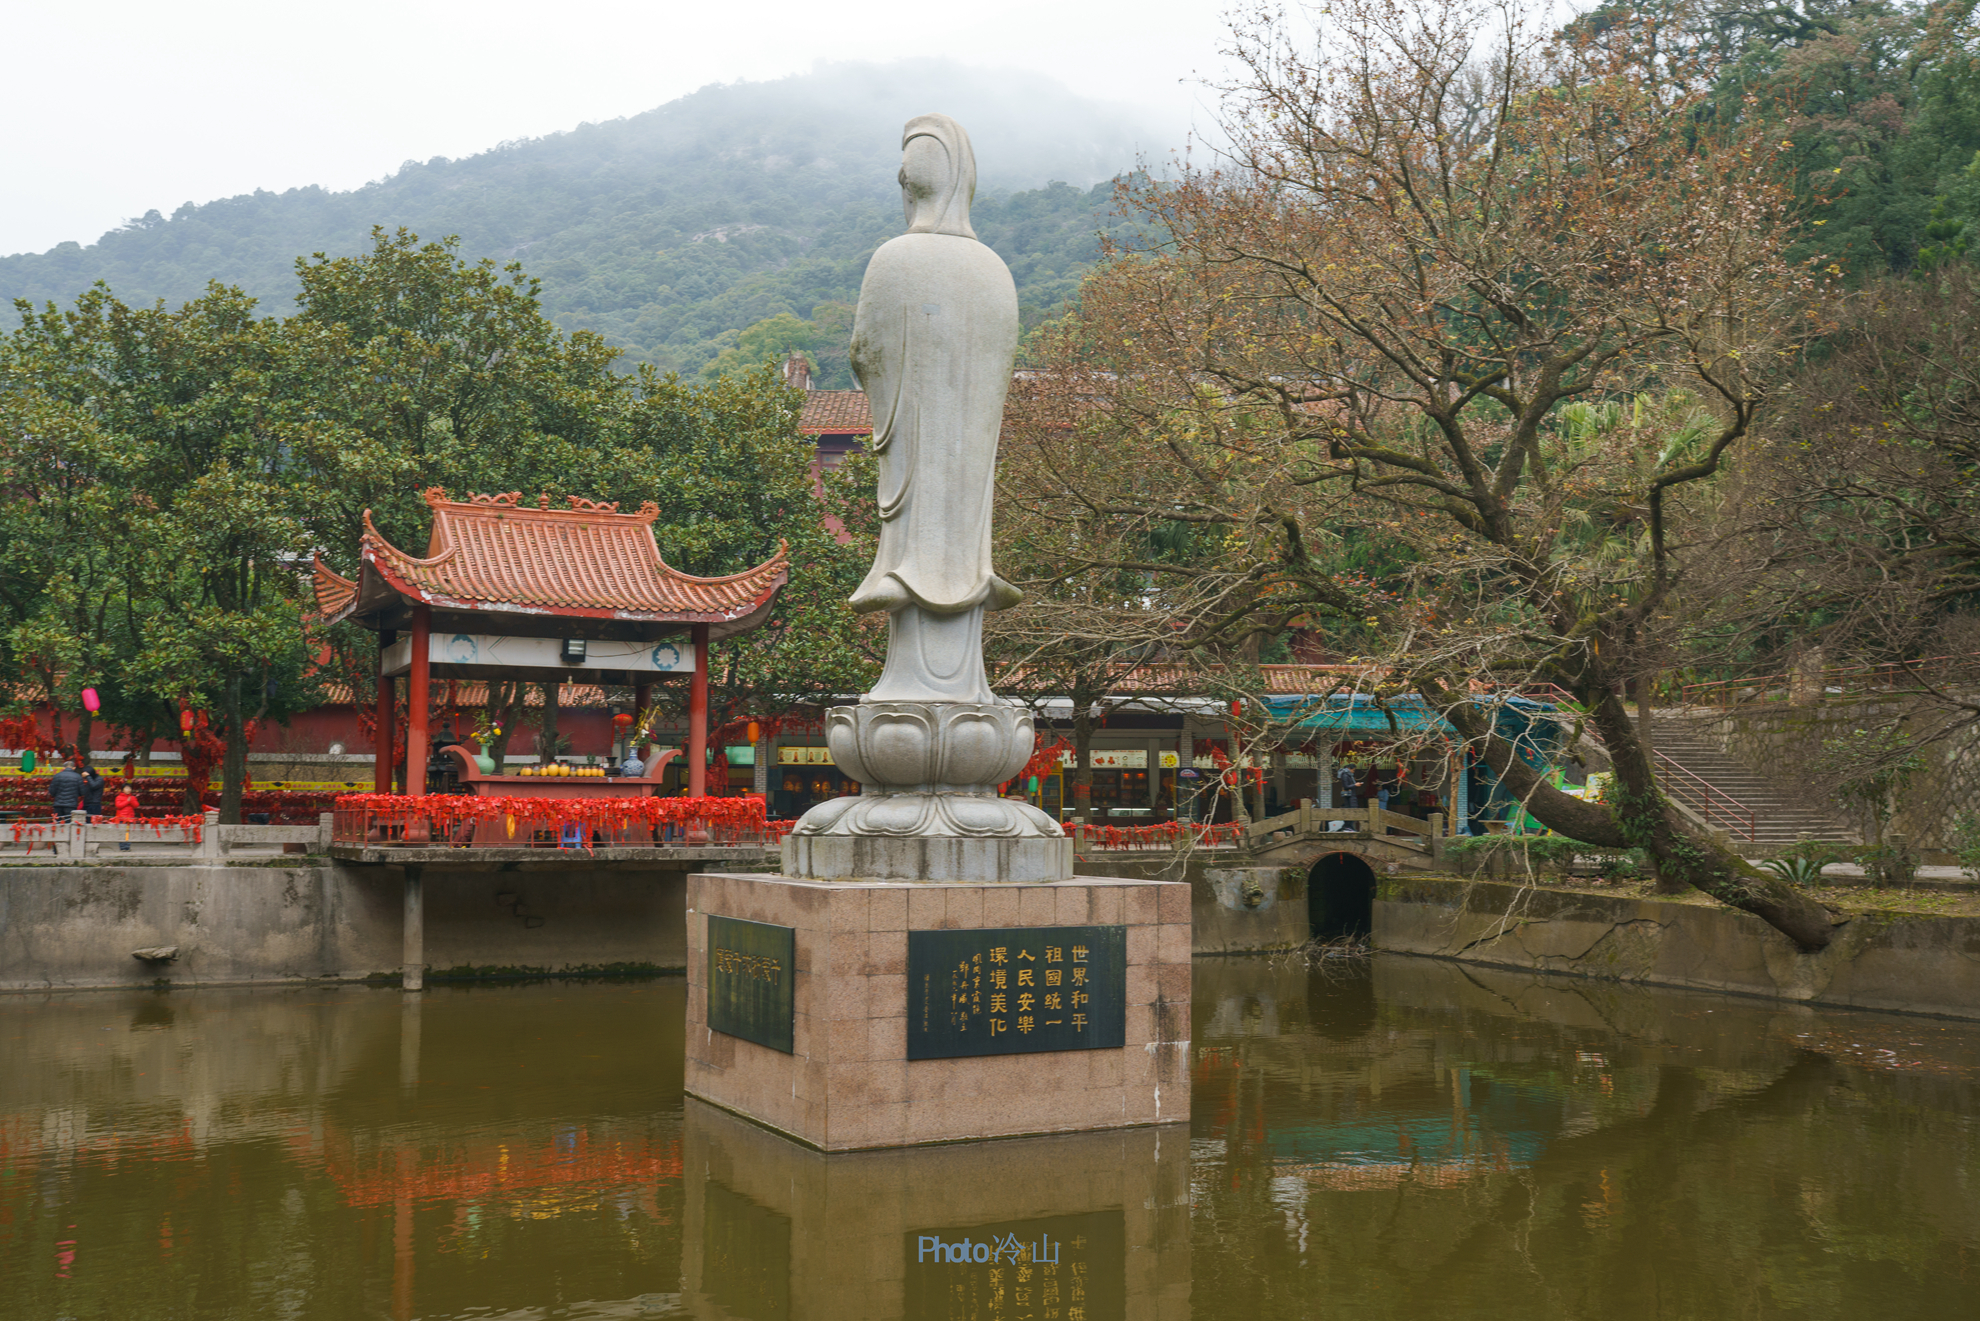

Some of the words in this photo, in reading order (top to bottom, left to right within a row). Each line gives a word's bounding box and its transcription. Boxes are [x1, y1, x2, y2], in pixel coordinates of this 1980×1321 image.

[989, 946, 1008, 1036] 環境美化
[1017, 948, 1036, 1034] 人民安樂
[1044, 944, 1063, 1026] 祖國統一
[1071, 944, 1089, 1033] 世界和平
